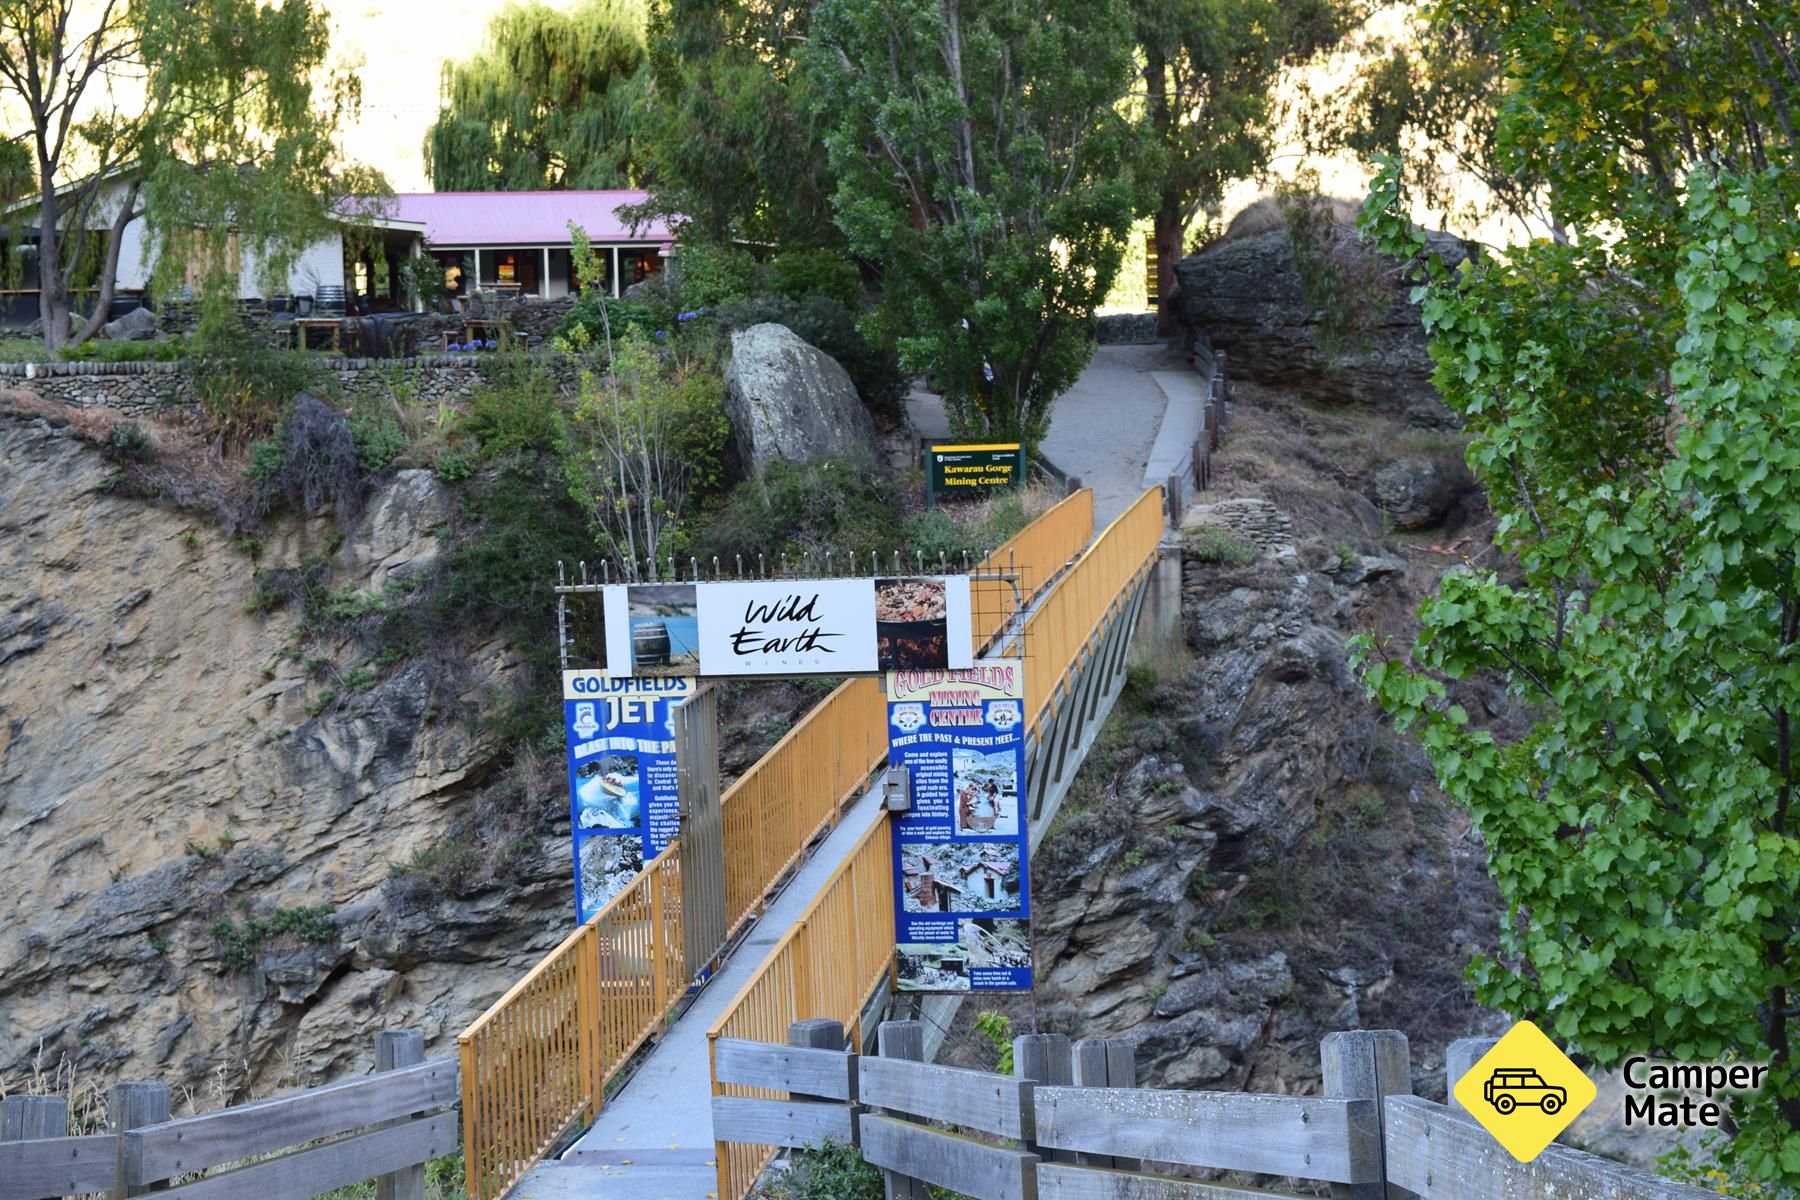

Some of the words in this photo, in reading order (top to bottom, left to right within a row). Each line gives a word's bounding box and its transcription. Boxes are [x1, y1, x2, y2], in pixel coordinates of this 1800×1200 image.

[986, 465, 1012, 473] Gorge
[945, 477, 977, 486] Mining
[745, 594, 824, 623] Wild
[729, 627, 846, 656] Earth
[572, 677, 687, 693] GOLDFIELDS
[894, 669, 944, 698] GOLD
[947, 665, 1014, 696] FIELDS
[930, 690, 982, 707] MINING
[606, 695, 660, 730] JET
[930, 709, 983, 726] CENTRE
[637, 739, 661, 753] THE
[892, 735, 917, 748] WHERE
[919, 733, 933, 742] THE
[935, 734, 952, 743] PAST
[954, 736, 961, 744] &
[962, 737, 993, 746] PRESENT
